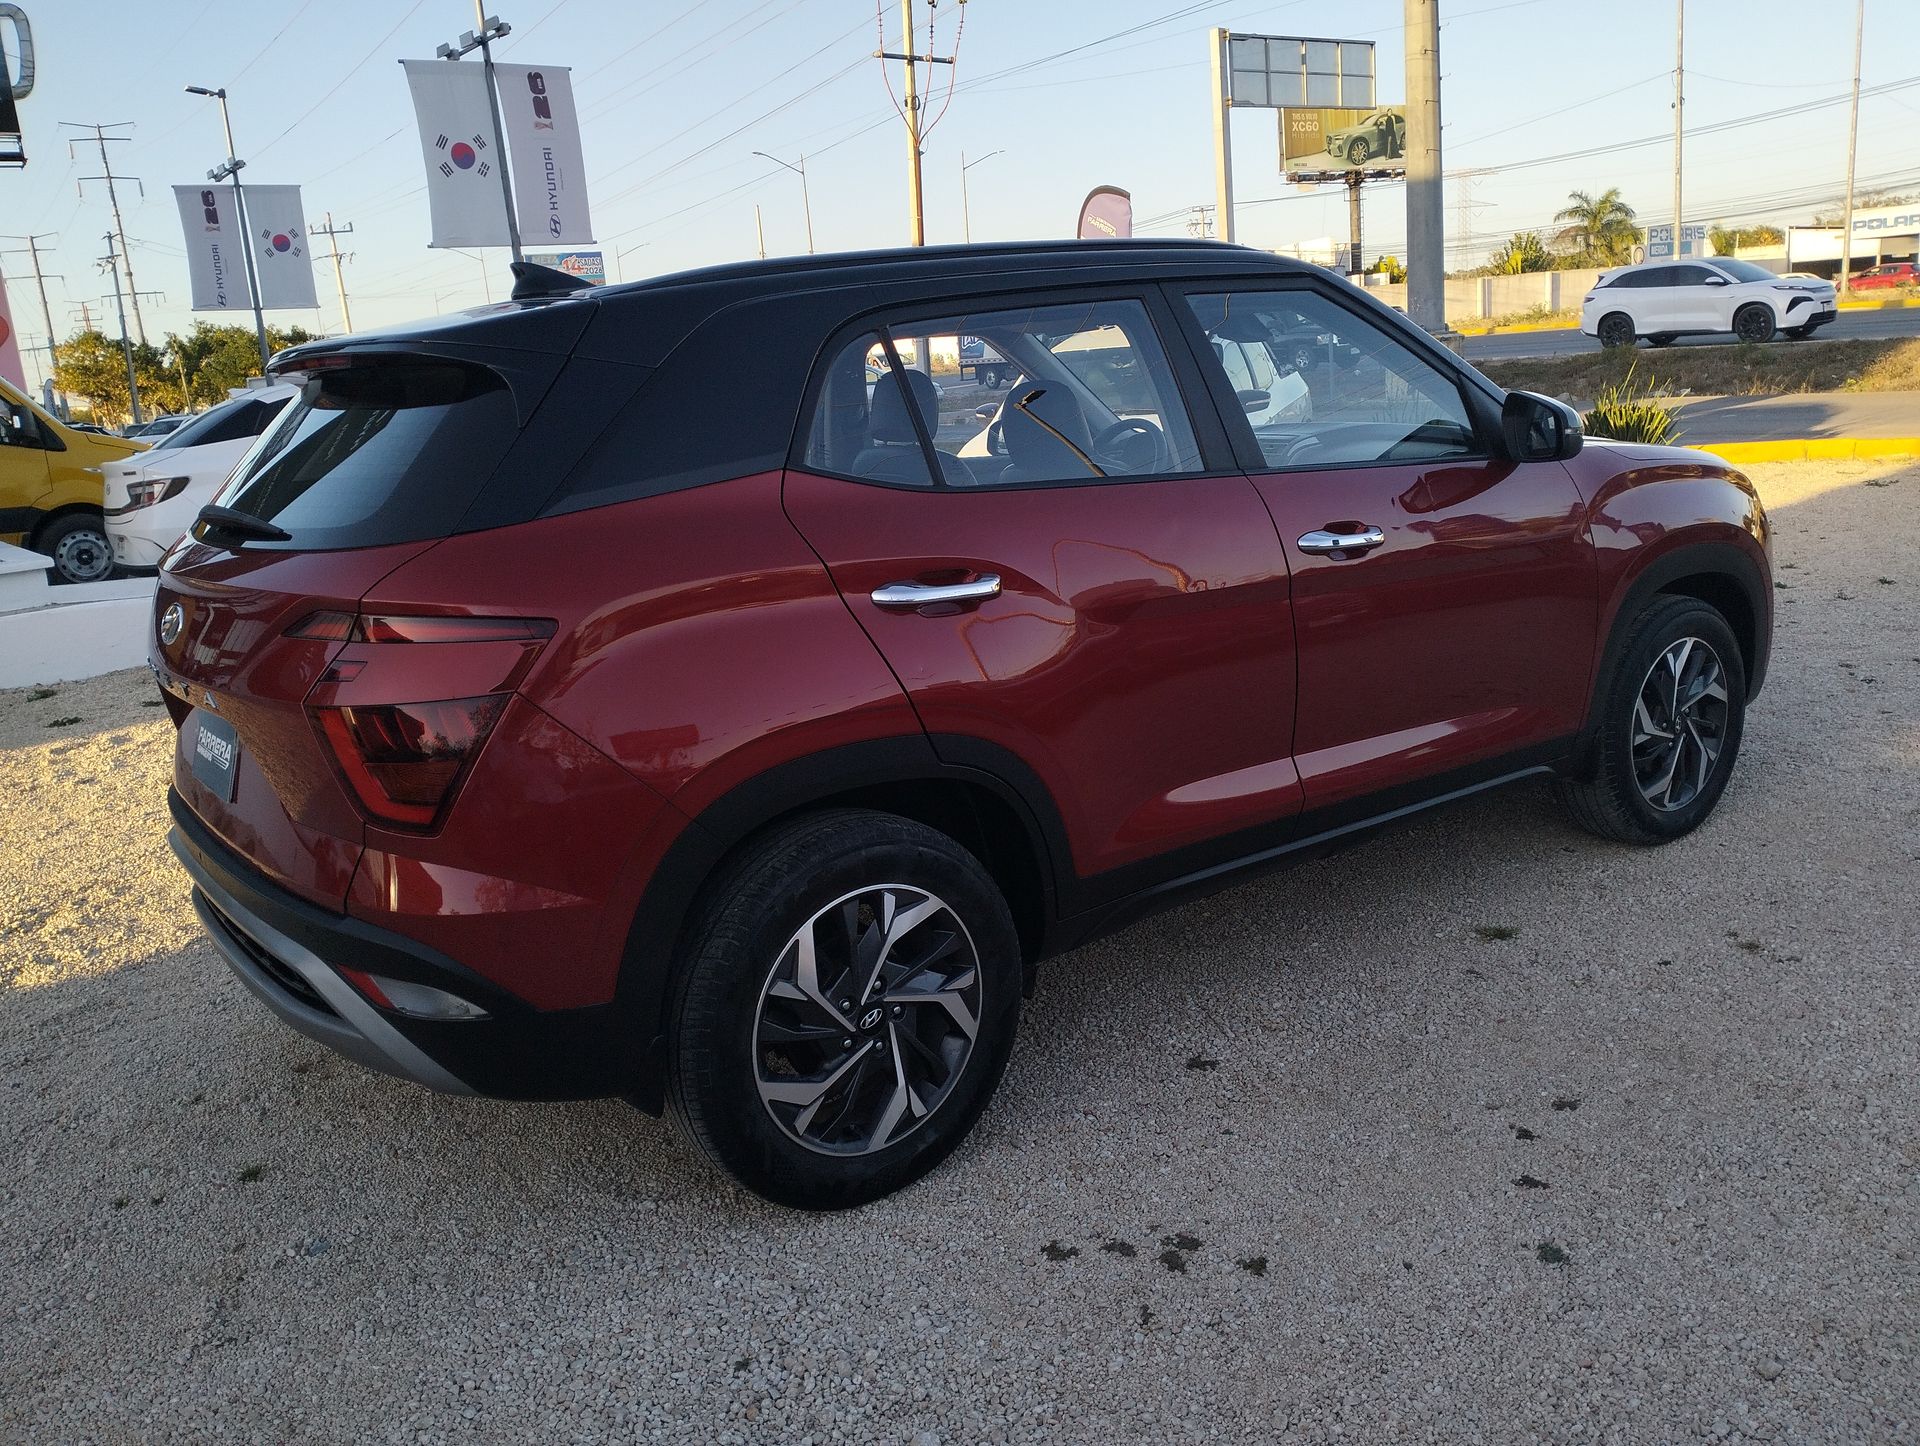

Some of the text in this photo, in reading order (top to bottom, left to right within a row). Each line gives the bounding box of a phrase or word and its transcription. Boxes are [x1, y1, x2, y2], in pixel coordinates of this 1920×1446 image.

[1292, 121, 1319, 132] XC60
[542, 147, 558, 210] HYUNDAI
[211, 244, 224, 289] HYUNDAI
[585, 267, 603, 275] 2026
[198, 726, 232, 762] FARRERA
